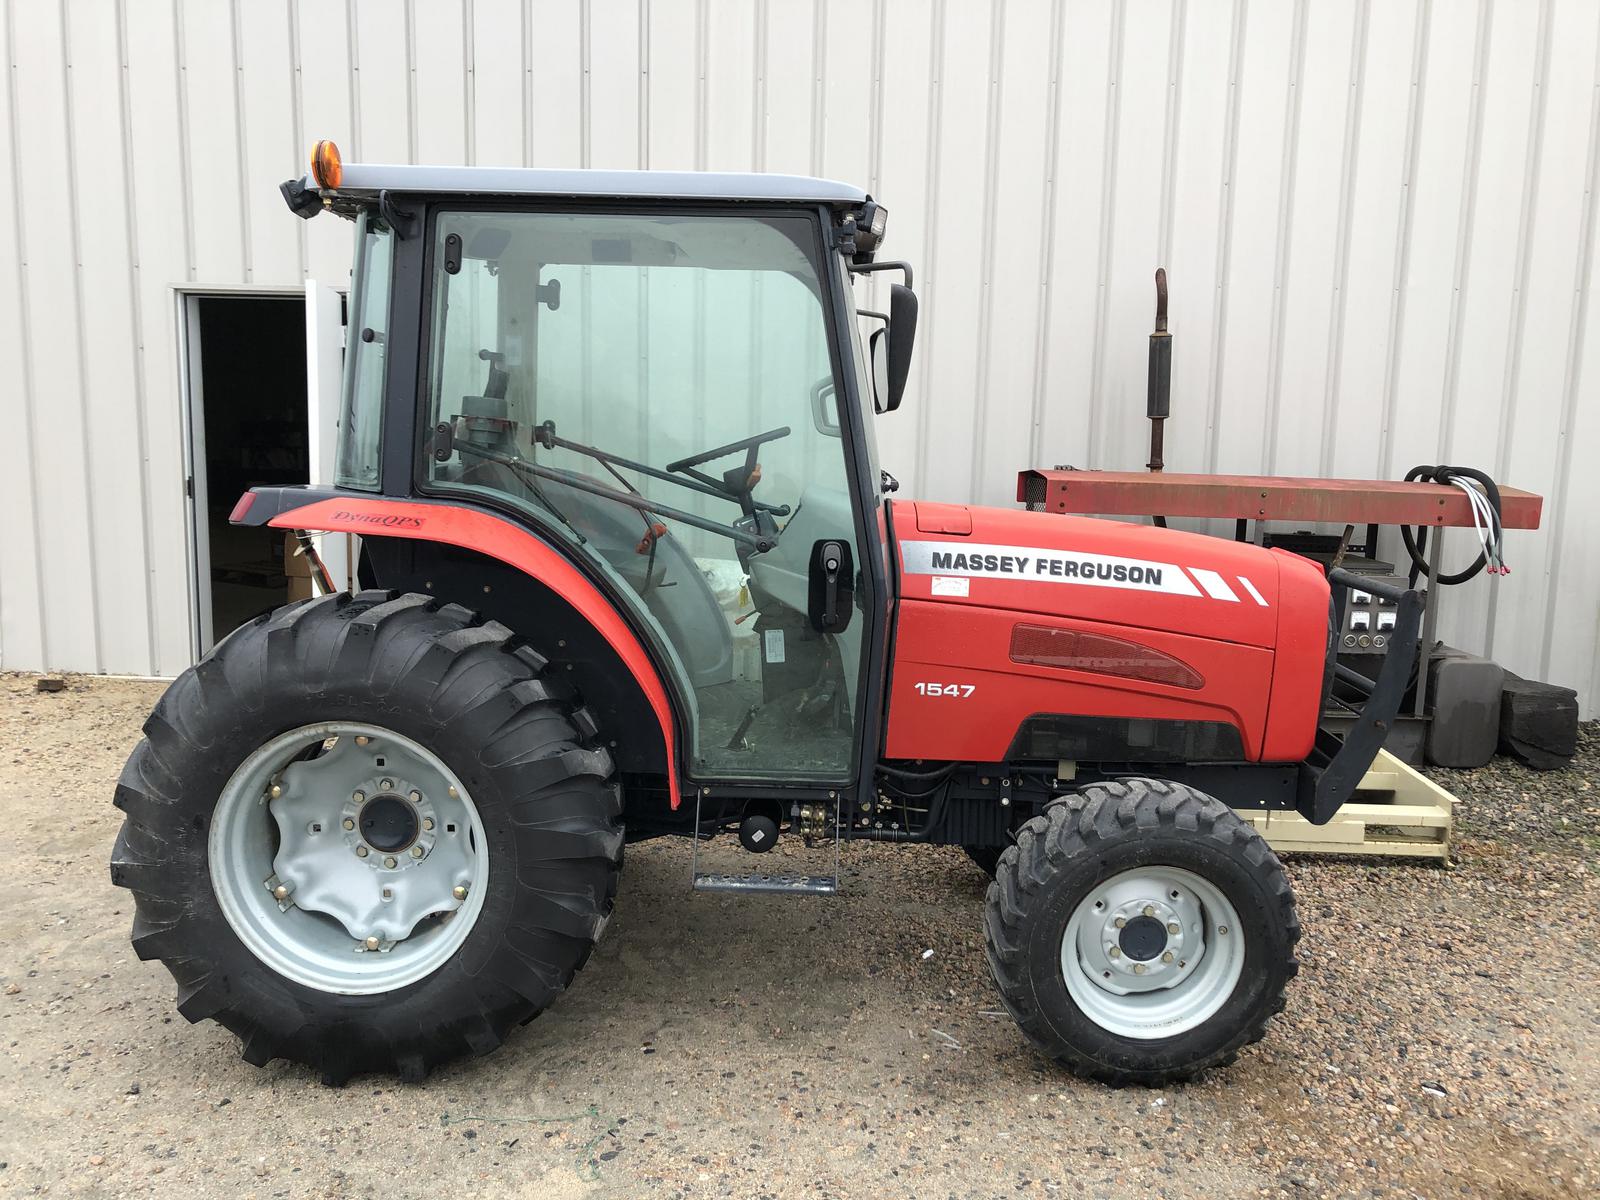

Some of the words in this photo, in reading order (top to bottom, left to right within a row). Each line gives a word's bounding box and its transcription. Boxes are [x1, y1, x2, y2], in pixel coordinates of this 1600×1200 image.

[332, 511, 423, 527] DynaQPS
[931, 551, 1029, 573] MASSEY
[1035, 558, 1162, 586] FERGUSON
[914, 682, 976, 698] 1547
